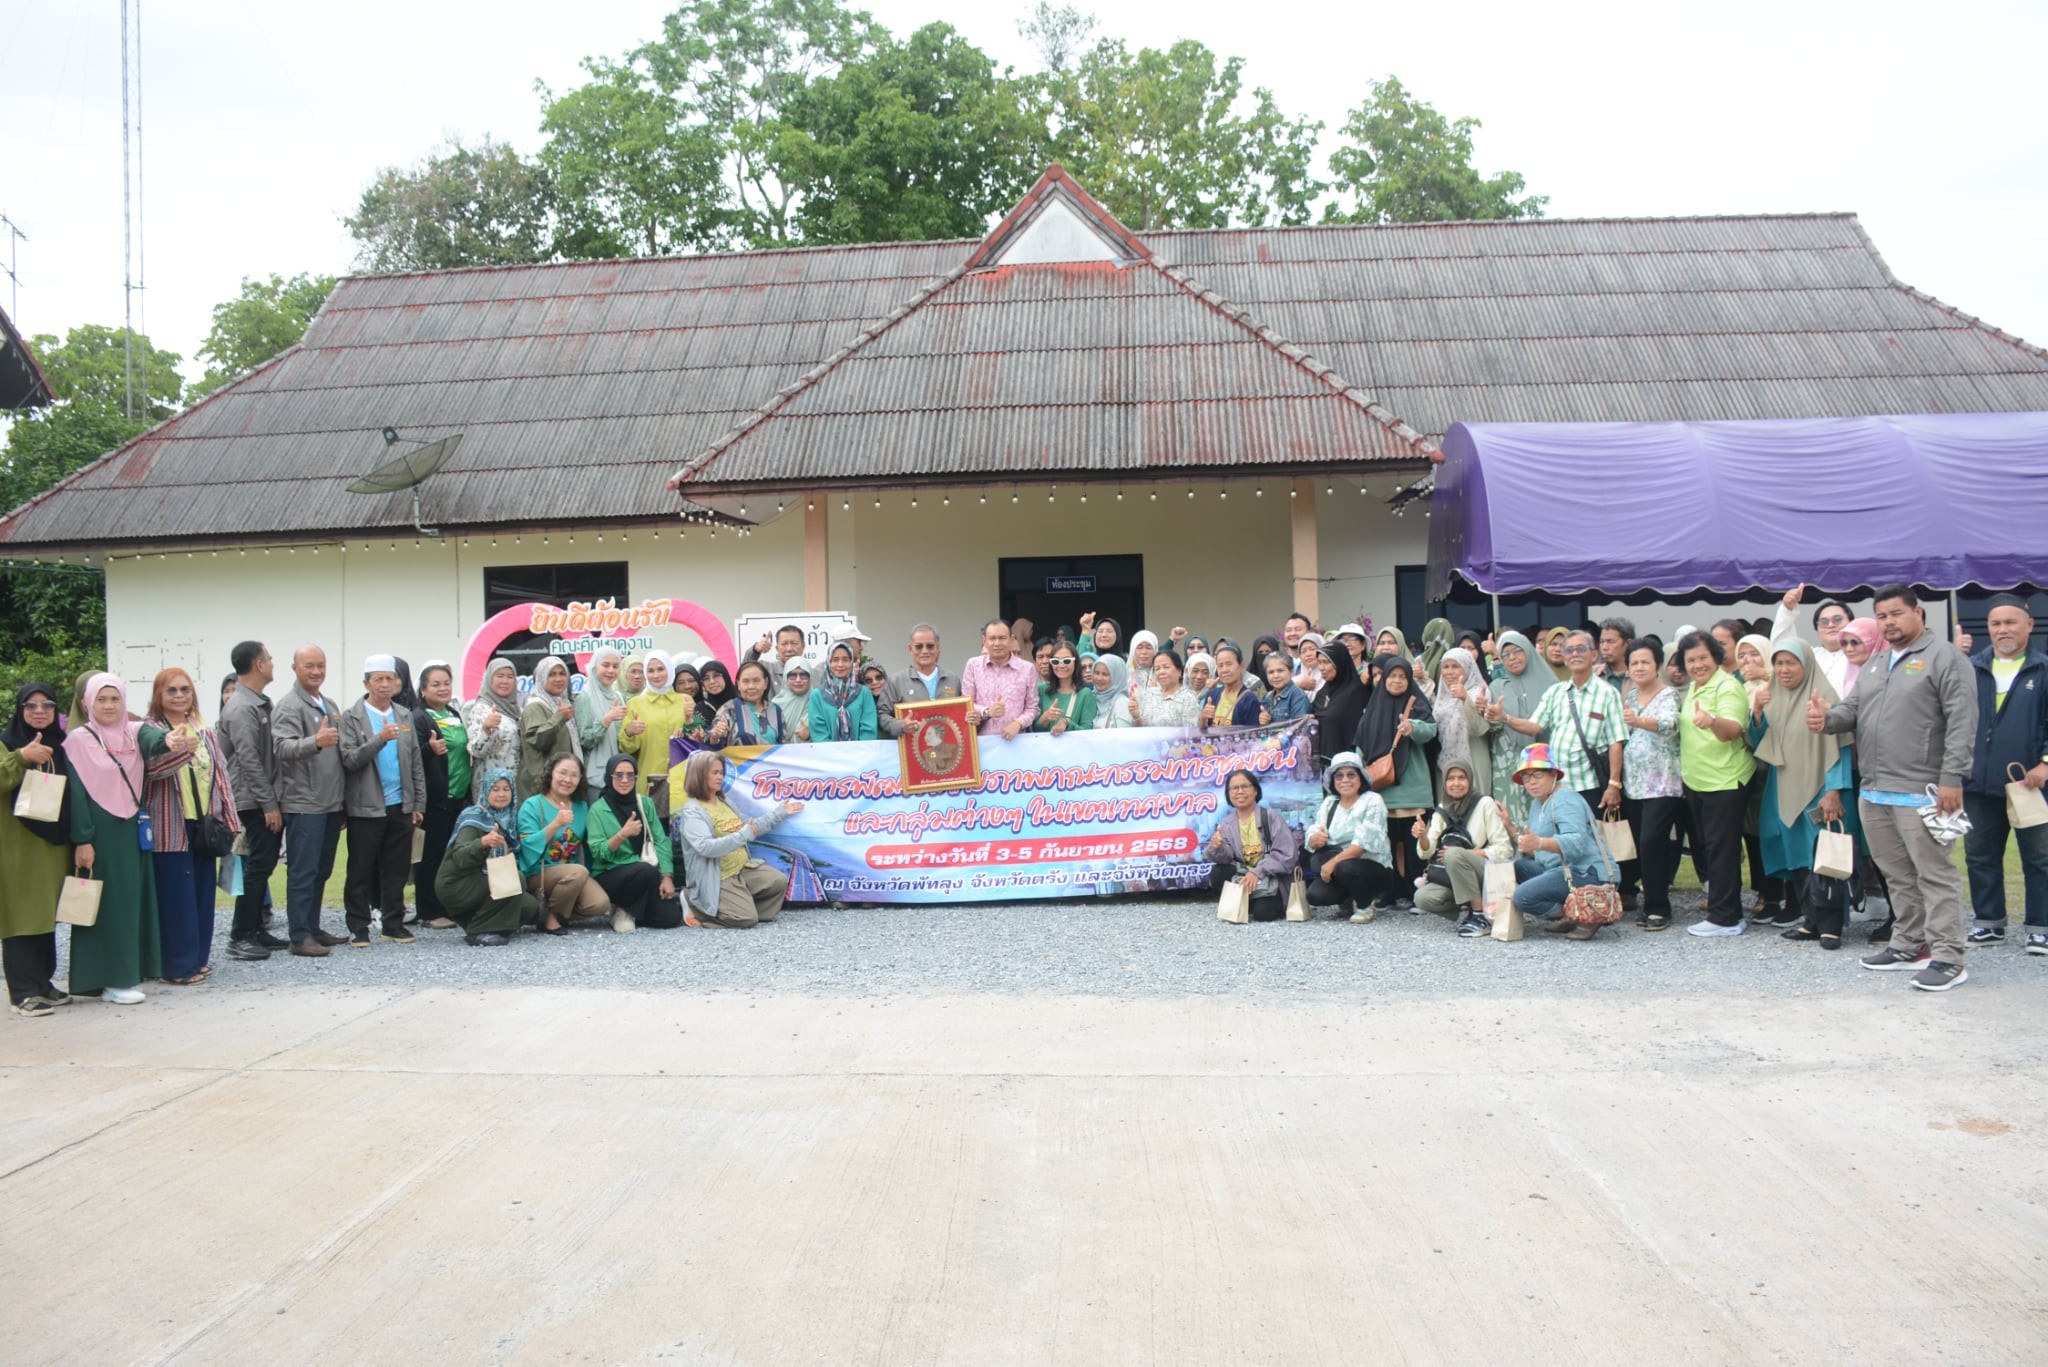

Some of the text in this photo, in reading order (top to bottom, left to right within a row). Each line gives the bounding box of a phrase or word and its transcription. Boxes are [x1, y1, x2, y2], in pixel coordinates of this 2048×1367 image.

[1051, 578, 1092, 591] ห้องประชุม
[532, 596, 671, 633] ยินดีต้อนรับ
[844, 790, 1218, 843] และกลุ่มต่างๆ ในเขตเทศบาล
[870, 836, 1189, 866] ระหว่างวันที่ 3-5 กันยายน 2568
[824, 877, 844, 891] ณ
[850, 875, 963, 895] จังหวัดพัทลุง
[970, 869, 1068, 889] จังหวัดตรัง
